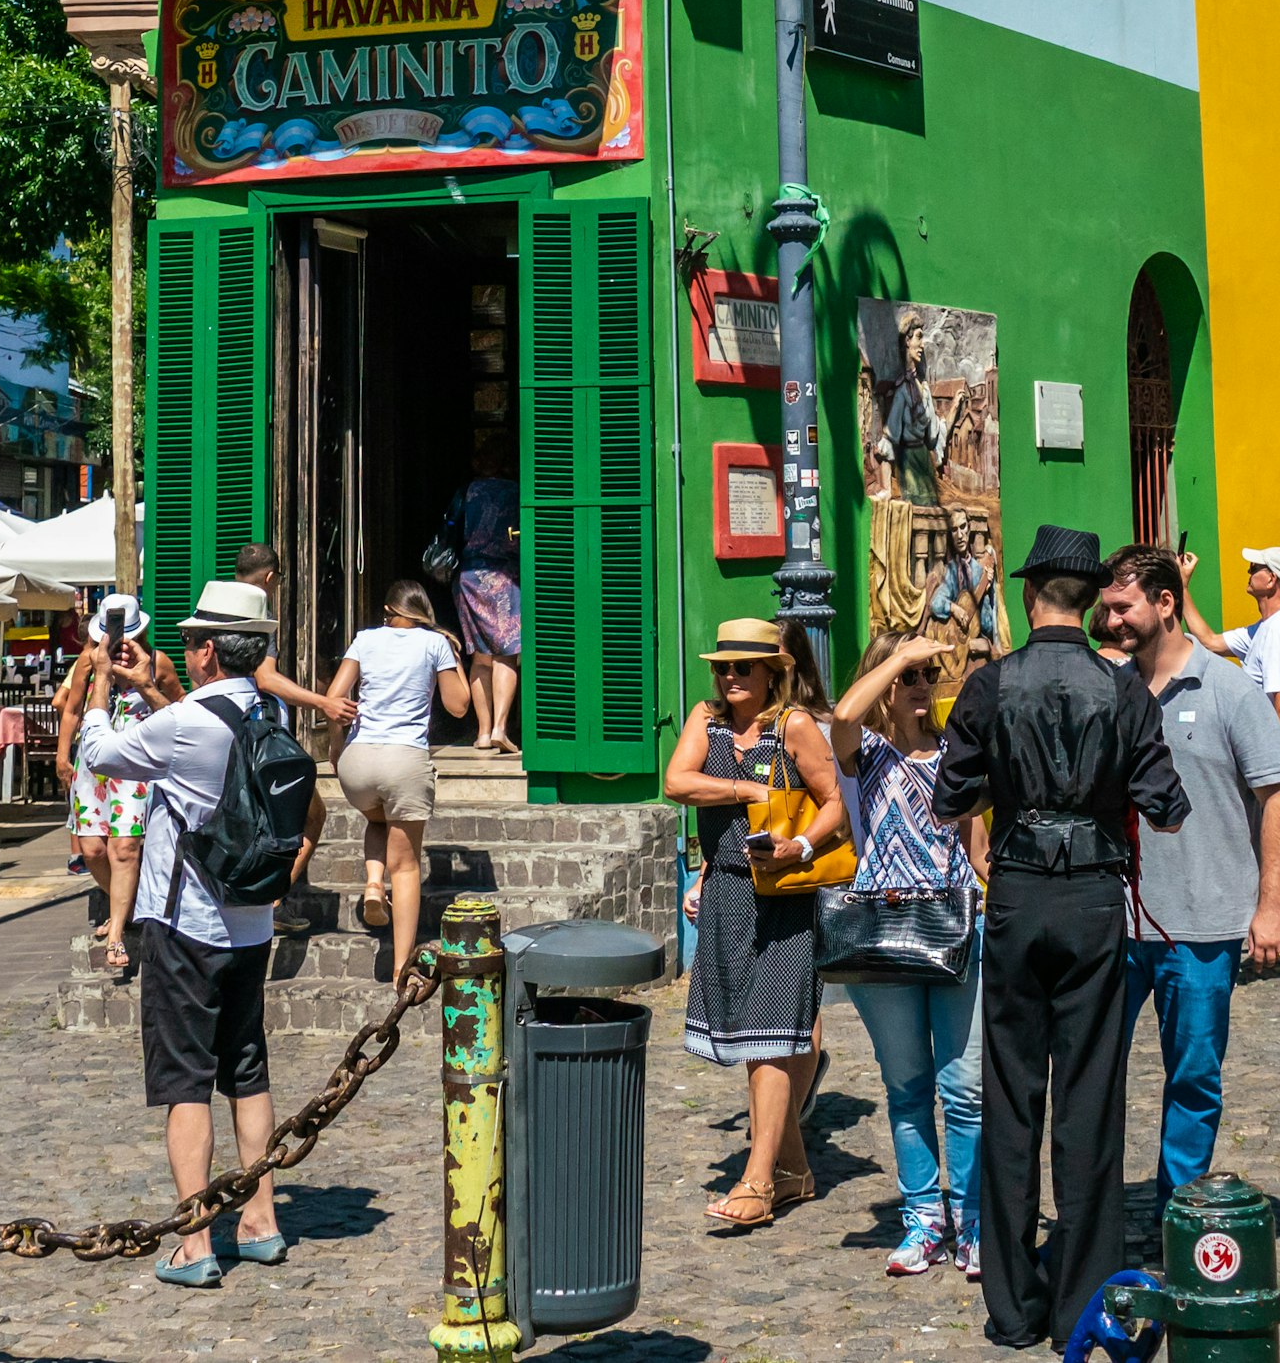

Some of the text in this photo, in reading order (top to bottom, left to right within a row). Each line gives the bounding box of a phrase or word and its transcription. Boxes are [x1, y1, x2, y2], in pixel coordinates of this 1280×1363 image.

[579, 34, 595, 56] H
[232, 22, 560, 112] CAMINITO
[887, 52, 916, 69] Comuna 4
[200, 65, 214, 85] H
[340, 113, 401, 143] DESDE
[716, 299, 778, 330] CAMINITO
